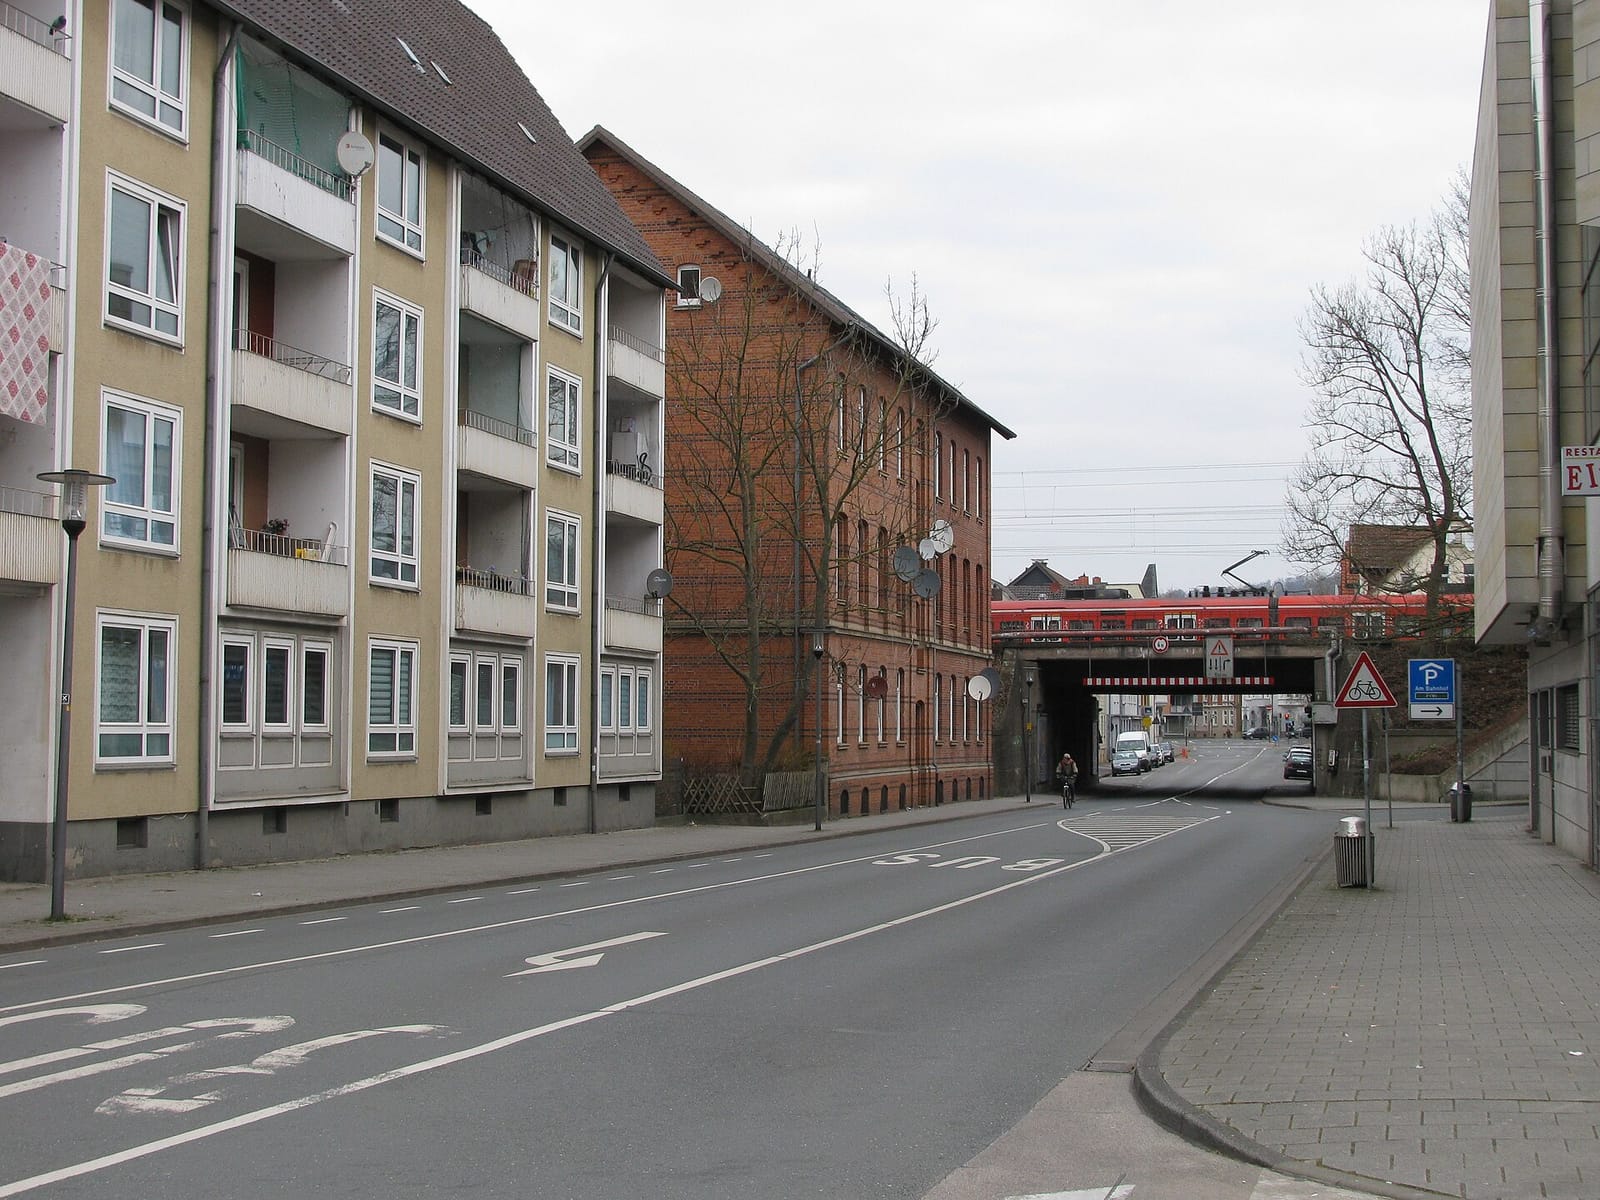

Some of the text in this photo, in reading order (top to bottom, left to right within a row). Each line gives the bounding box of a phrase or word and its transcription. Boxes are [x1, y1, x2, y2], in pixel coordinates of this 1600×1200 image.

[1566, 462, 1600, 491] EI
[1425, 669, 1438, 685] P
[871, 853, 1065, 872] BUS
